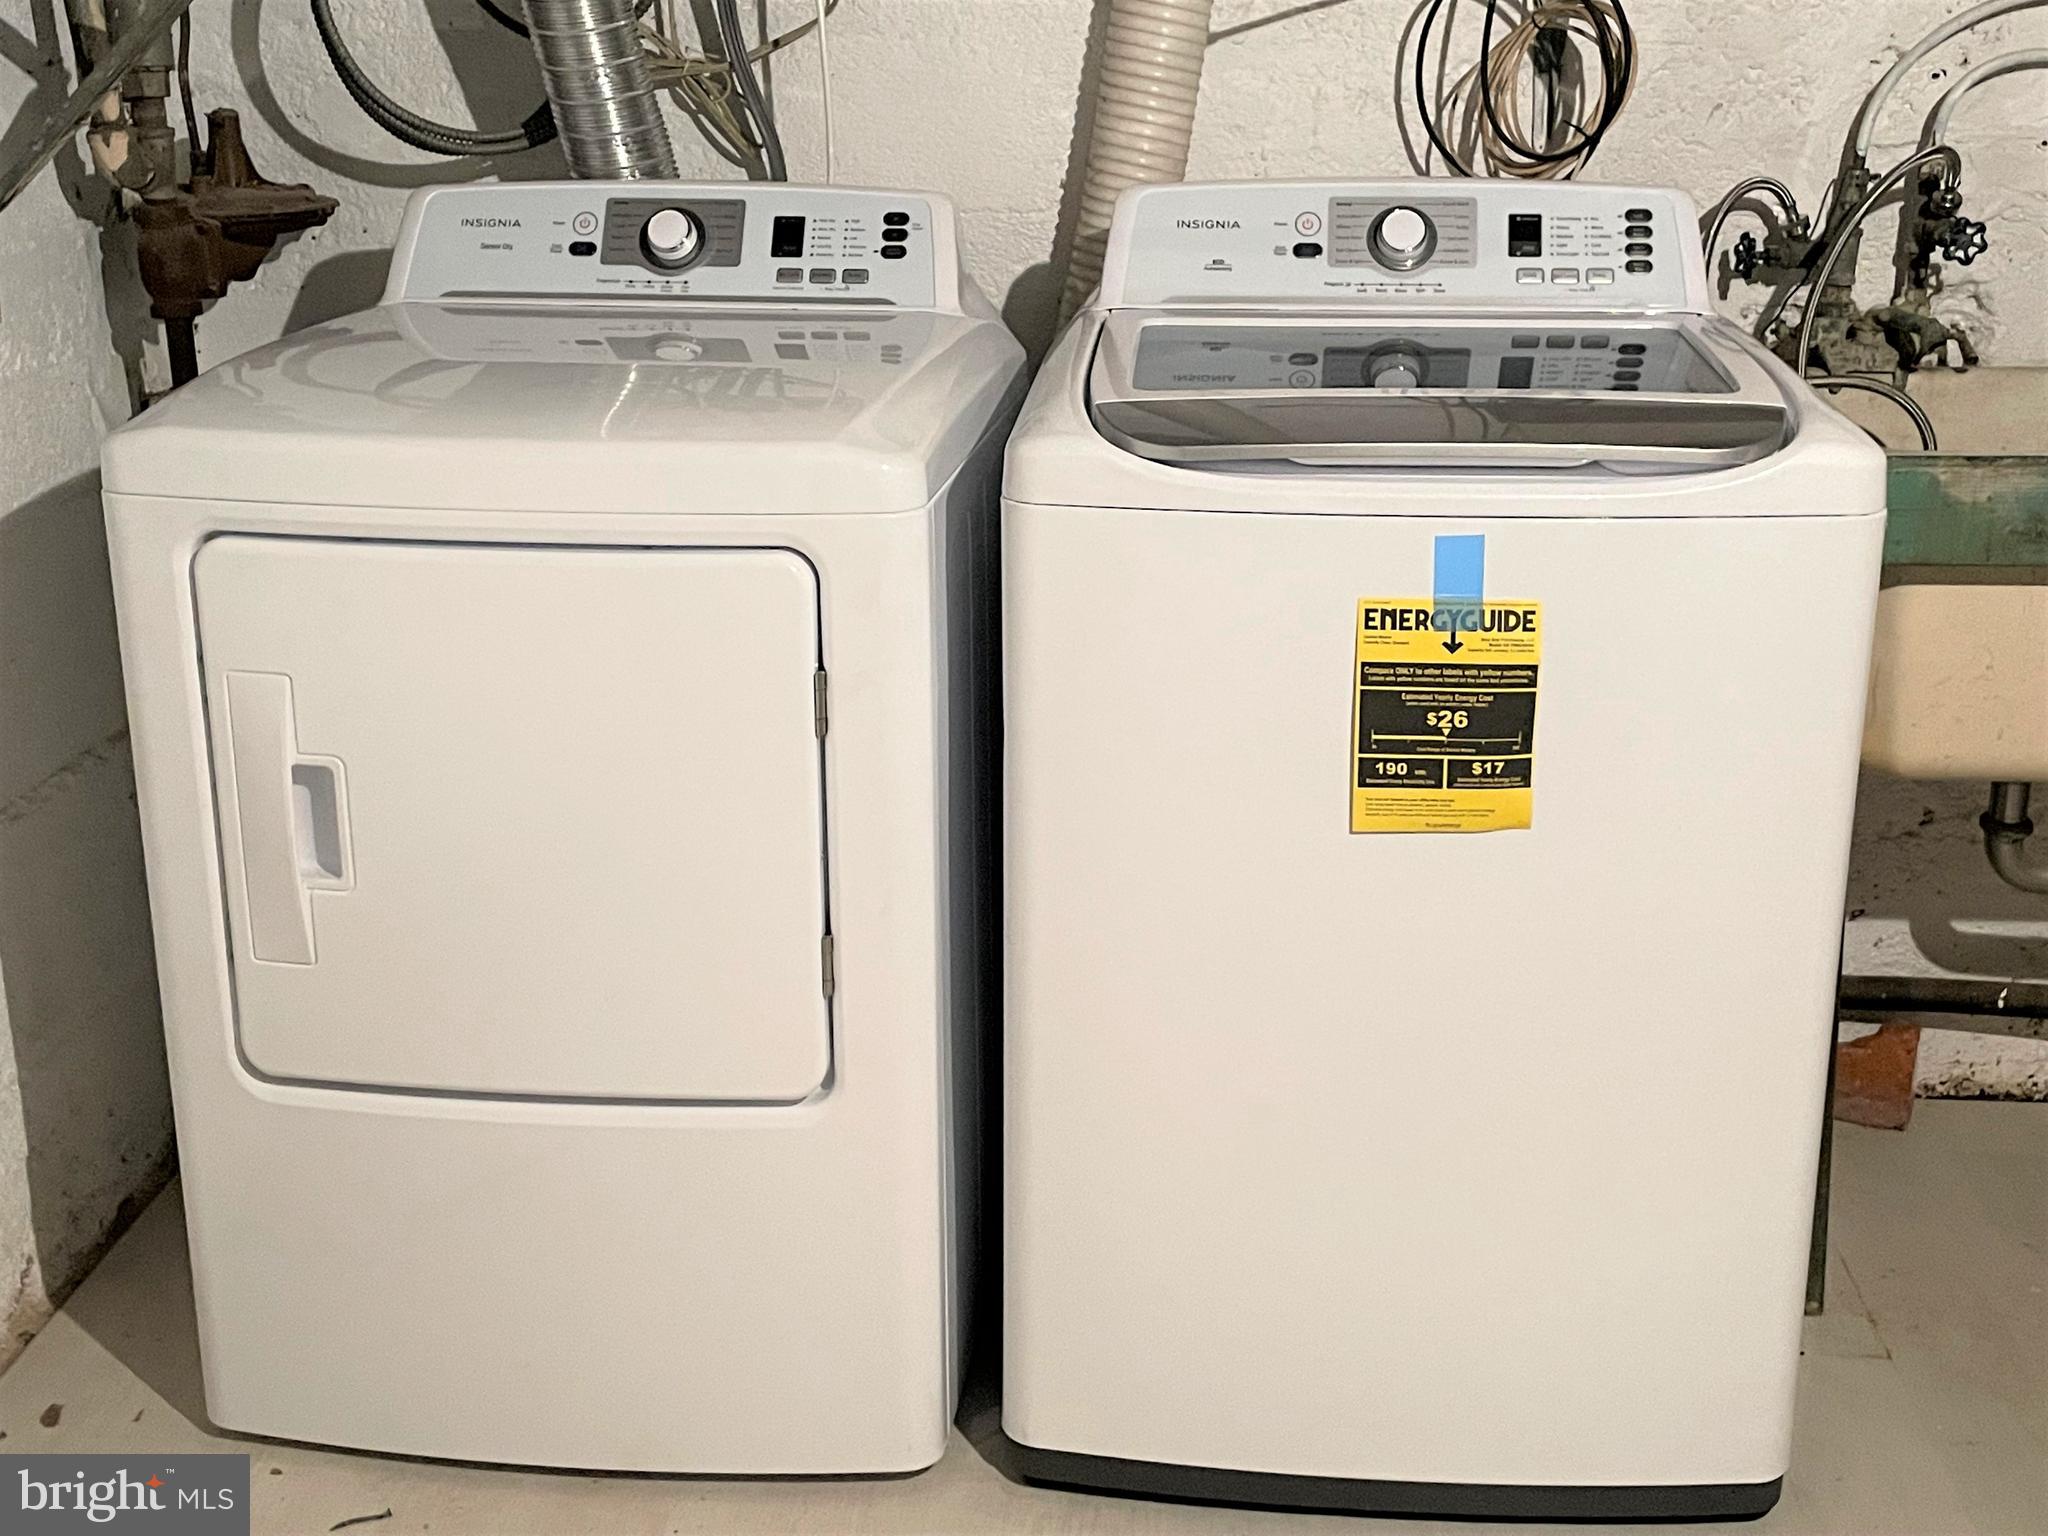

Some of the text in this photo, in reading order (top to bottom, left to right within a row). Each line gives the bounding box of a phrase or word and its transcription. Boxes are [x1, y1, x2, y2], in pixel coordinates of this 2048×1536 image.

[461, 218, 522, 228] INSIGNIA
[1176, 219, 1241, 230] INSIGNIA
[1364, 608, 1536, 632] ENERGYGUIDE
[1426, 710, 1469, 728] $26
[1375, 762, 1408, 775] 190
[1471, 761, 1505, 775] $17
